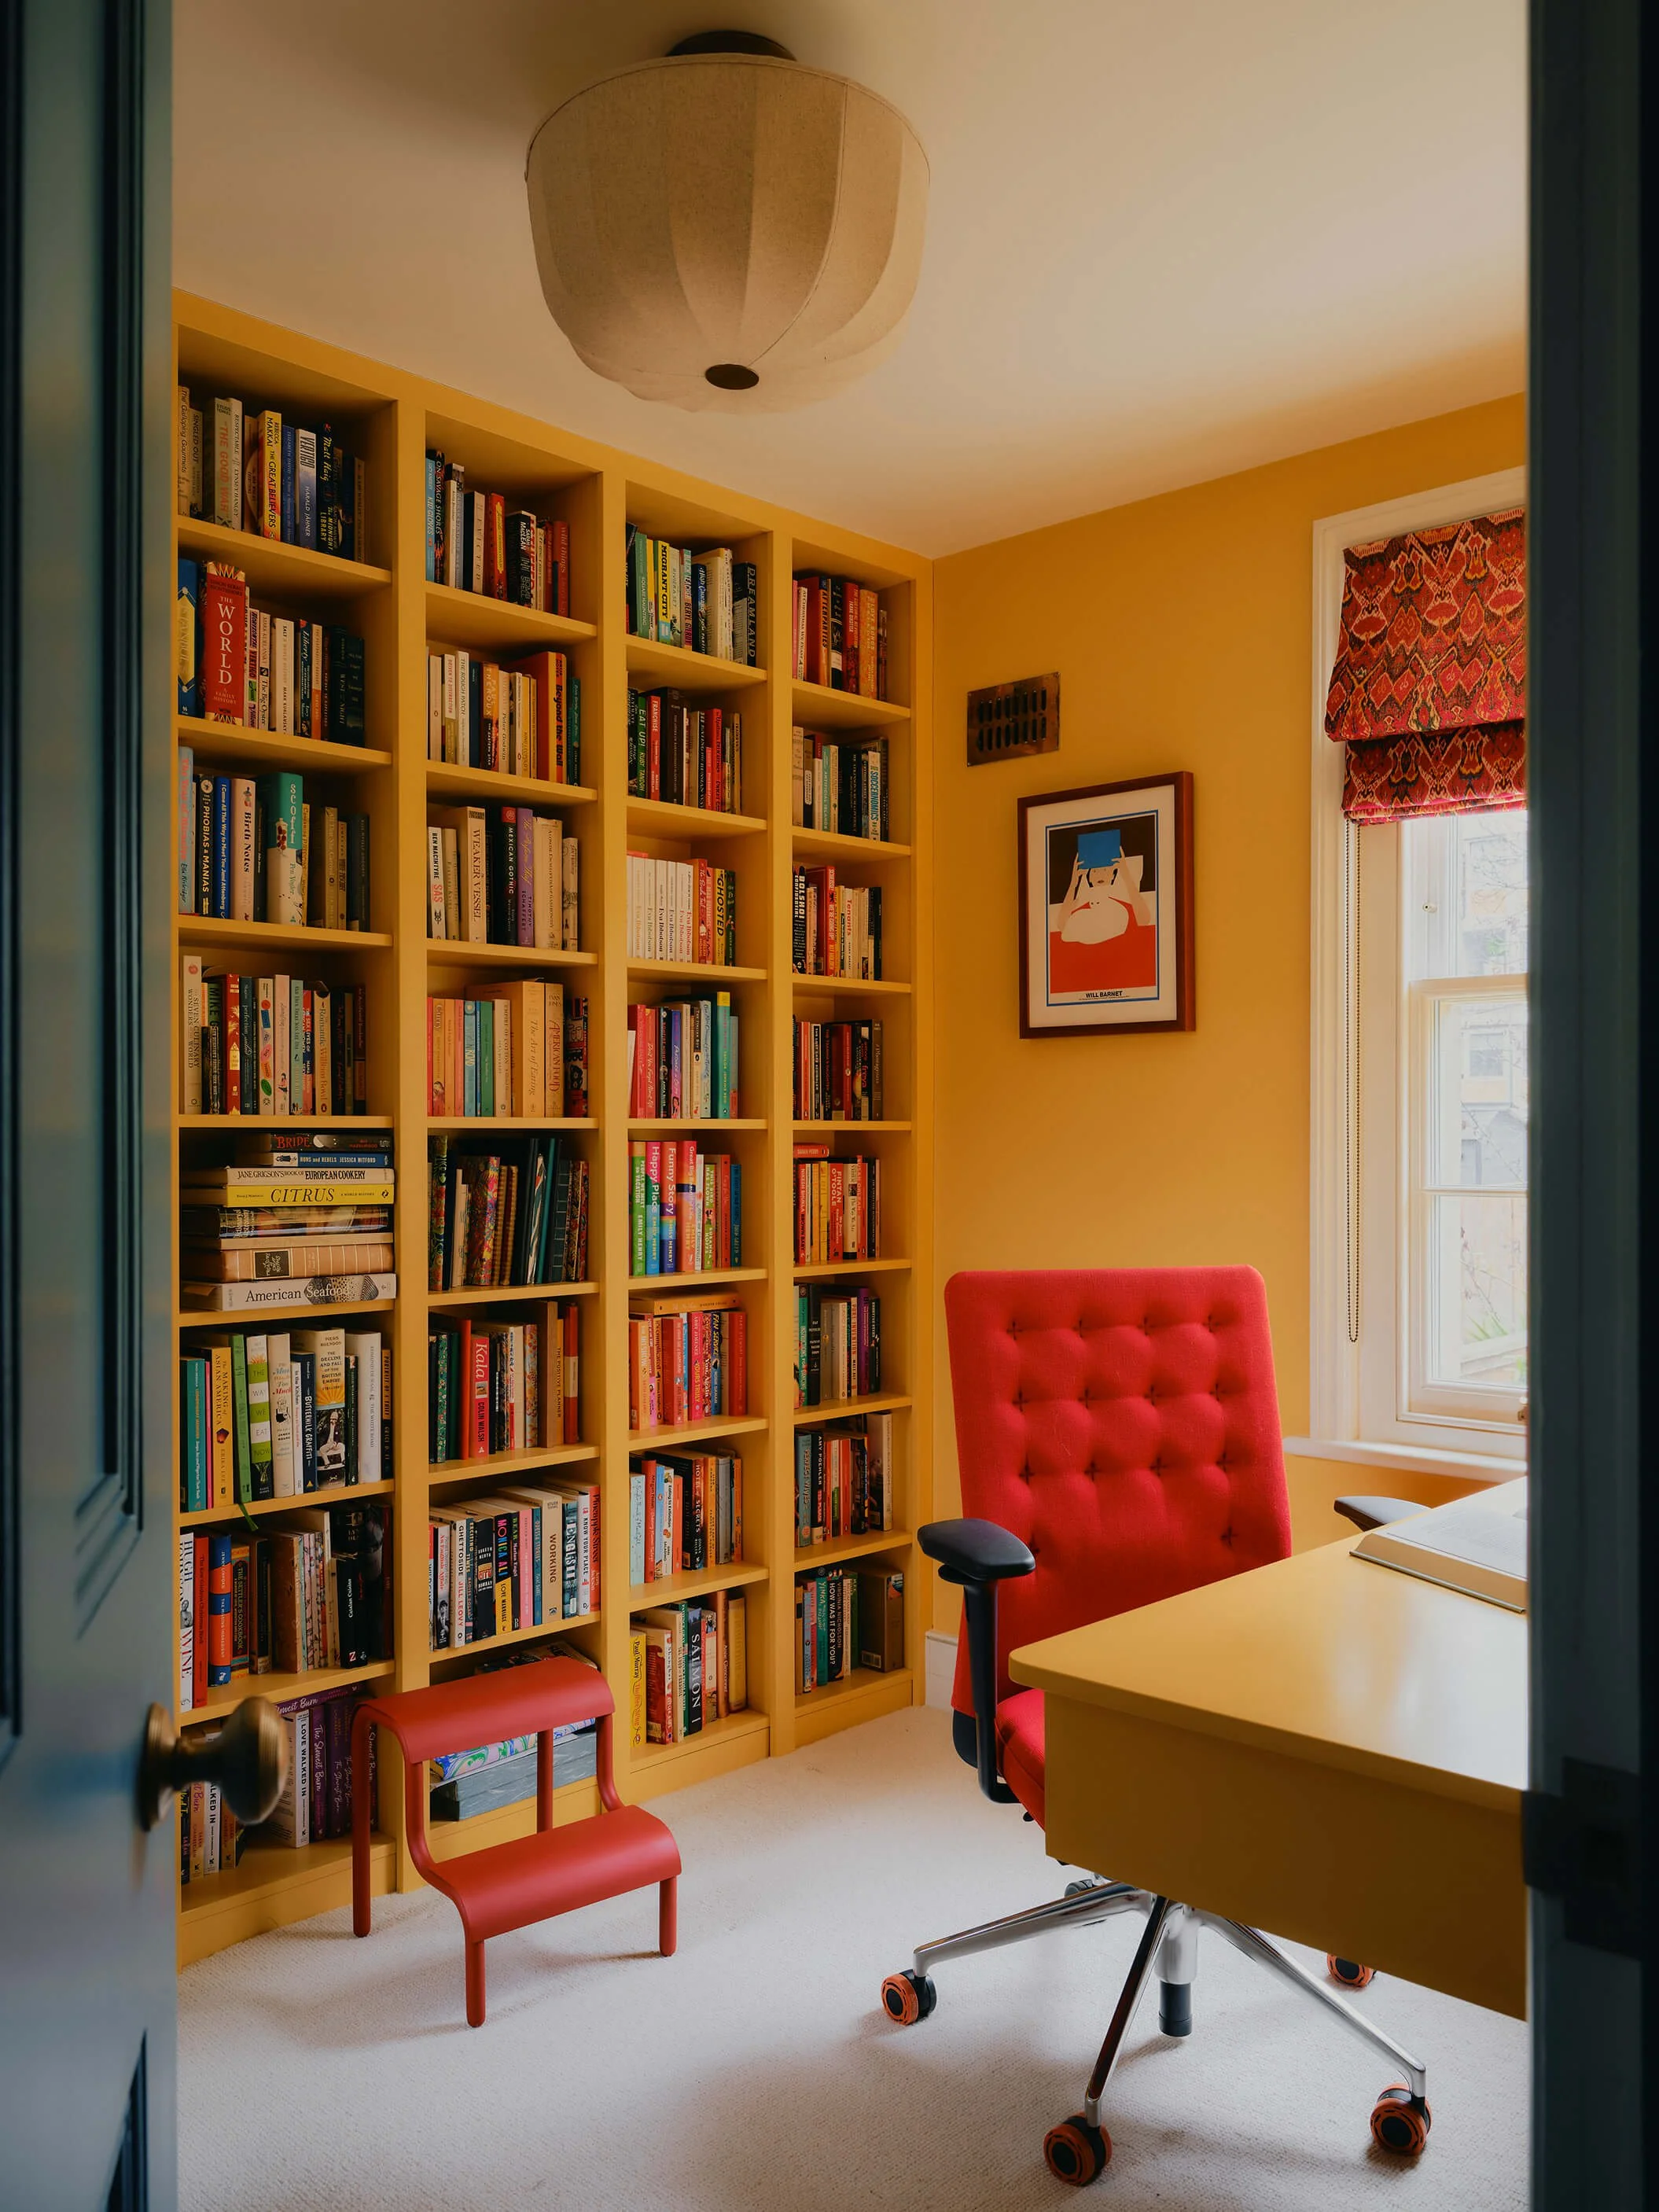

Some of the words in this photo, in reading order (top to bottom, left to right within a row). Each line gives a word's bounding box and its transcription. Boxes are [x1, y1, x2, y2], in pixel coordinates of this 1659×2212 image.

[300, 436, 315, 469] VERTIGO
[322, 437, 332, 458] Matt
[319, 461, 331, 481] Haig
[436, 461, 440, 473] ON
[218, 603, 236, 684] WORLD
[554, 684, 563, 722] Beyond
[433, 884, 443, 903] SAS
[210, 988, 220, 1016] MIKE
[530, 1020, 539, 1035] The
[530, 1040, 539, 1054] Art
[550, 1020, 561, 1065] AMERICAN
[530, 1055, 539, 1066] of
[529, 1067, 539, 1095] Eating
[277, 1135, 311, 1149] BRIDE
[650, 1146, 659, 1181] Happy
[667, 1148, 675, 1181] Funny
[305, 1171, 337, 1180] EUROPEAN
[338, 1170, 365, 1180] COOKERY
[270, 1188, 335, 1202] CITRUS
[666, 1184, 675, 1214] Story
[245, 1290, 301, 1302] American
[476, 1342, 487, 1379] Kala
[255, 1448, 270, 1456] NOW
[589, 1494, 601, 1536] Pineapple
[496, 1518, 508, 1559] MONICA
[497, 1562, 508, 1577] ALI
[182, 1629, 192, 1678] WINE
[692, 1634, 701, 1708] SALMON
[315, 1725, 323, 1739] The
[315, 1741, 324, 1769] Slowest
[315, 1771, 324, 1792] Burn
[301, 1788, 307, 1797] IN
